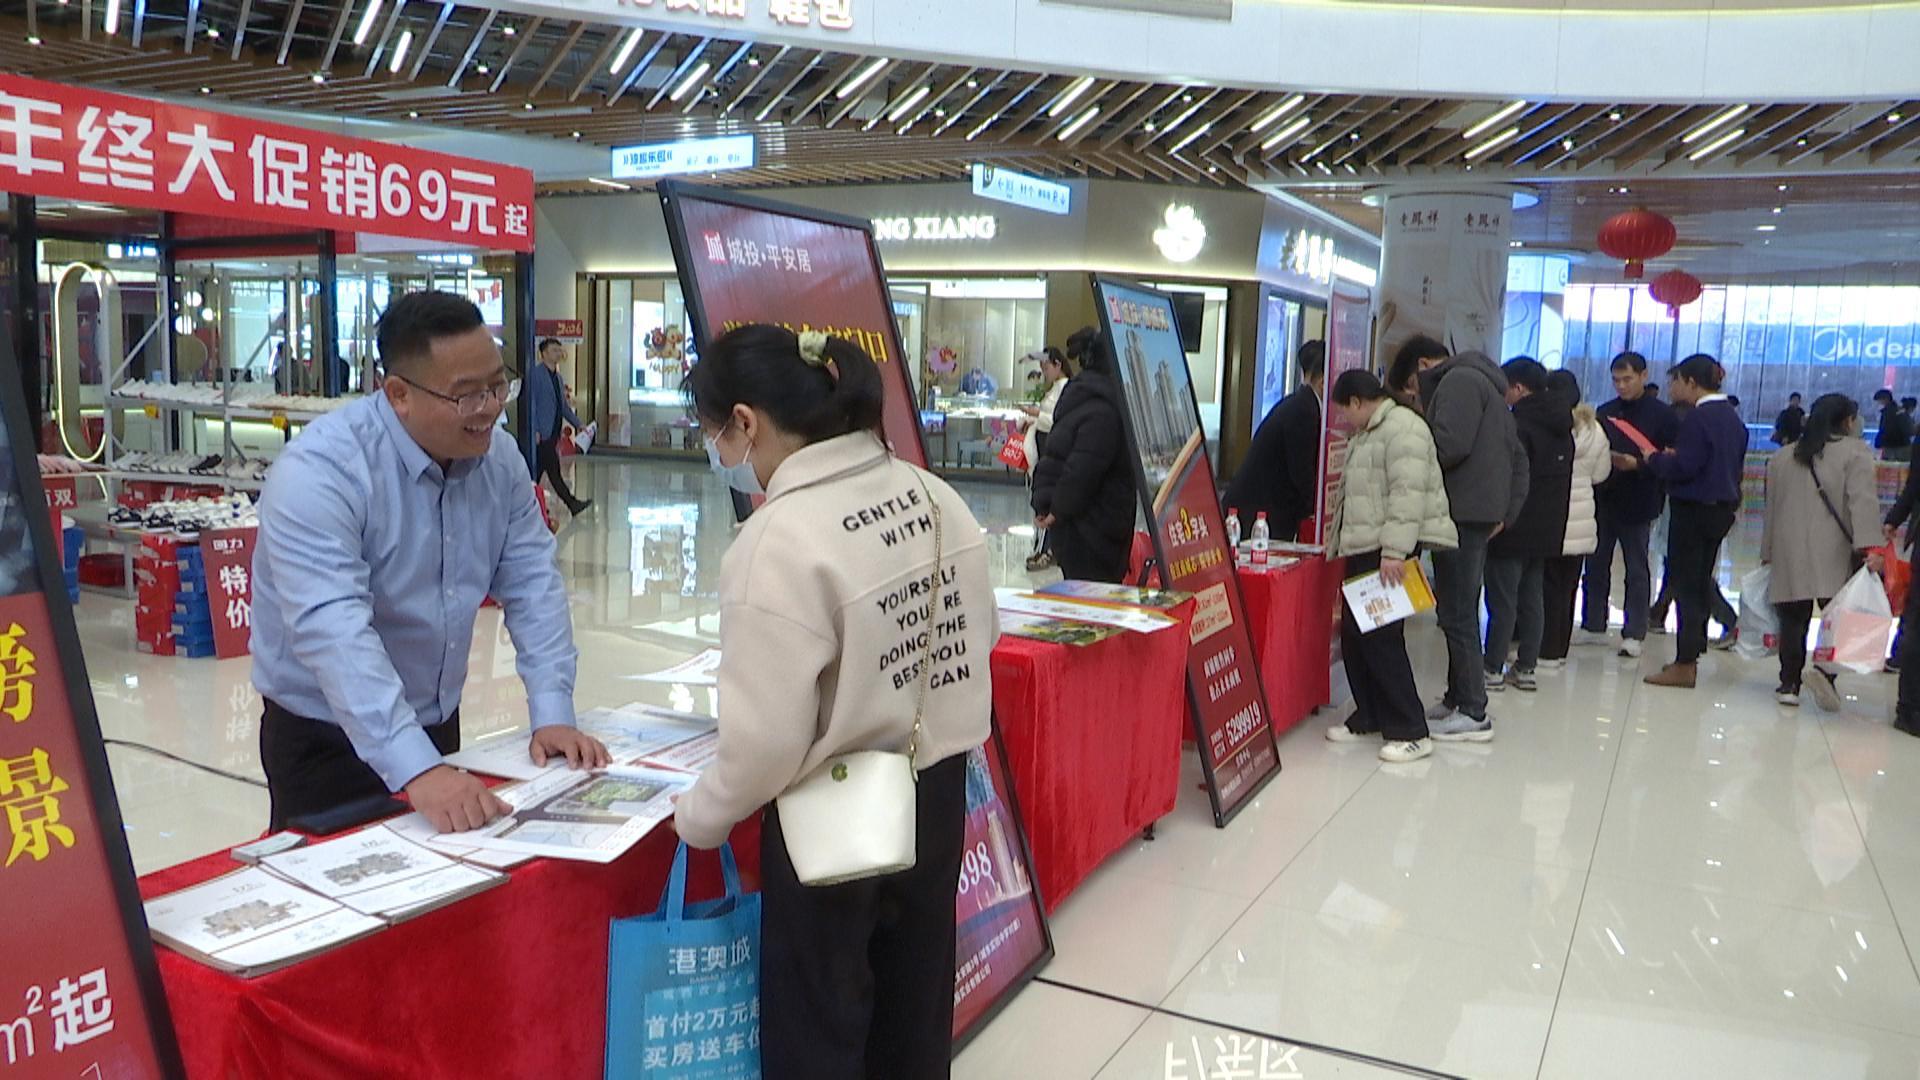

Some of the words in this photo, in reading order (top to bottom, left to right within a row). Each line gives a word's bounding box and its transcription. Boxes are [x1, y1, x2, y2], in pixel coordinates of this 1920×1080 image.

[912, 214, 996, 240] XIANG
[842, 488, 921, 532] GENTLE
[879, 513, 933, 548] WITH
[219, 563, 251, 629] 特价
[936, 614, 967, 639] THE
[930, 639, 966, 664] YOU
[930, 663, 970, 690] CAN
[1226, 700, 1262, 747] 5299919
[668, 936, 751, 976] 港澳城
